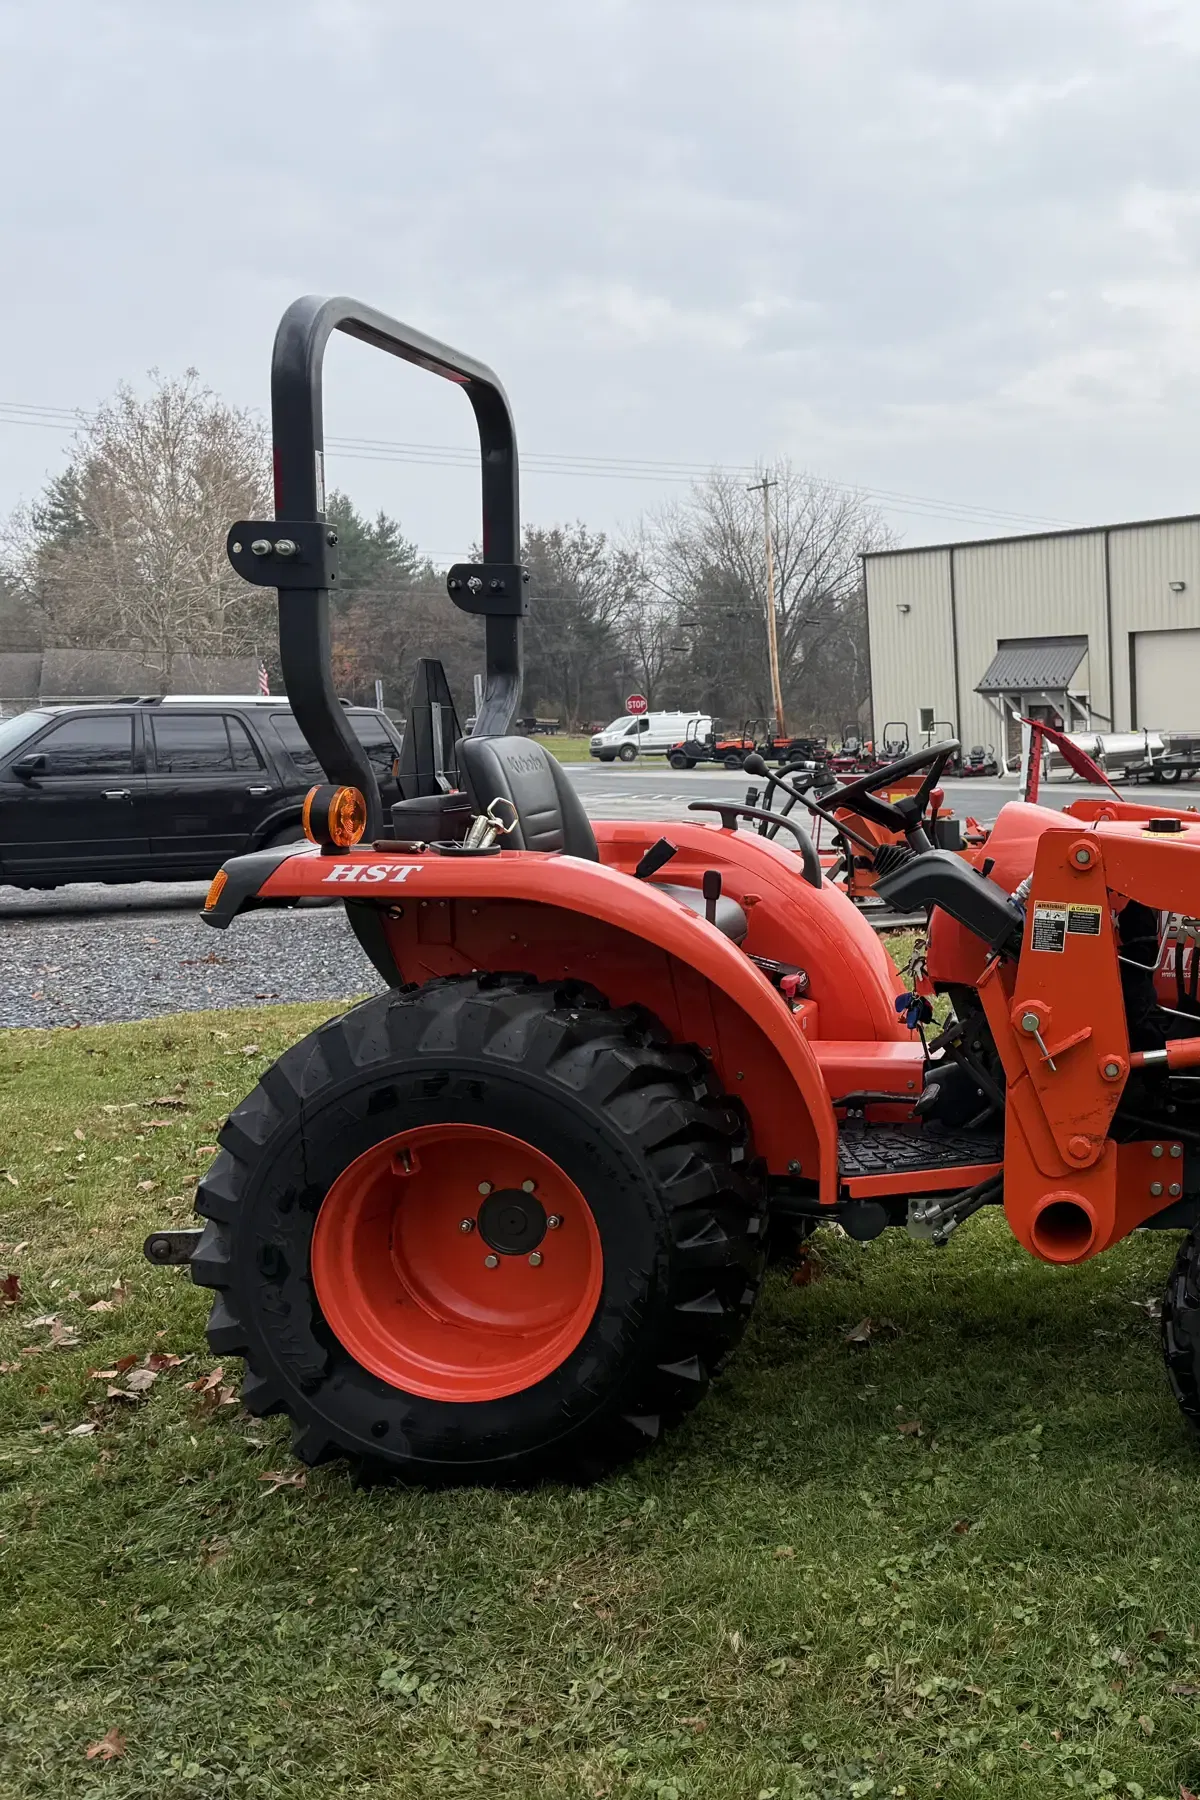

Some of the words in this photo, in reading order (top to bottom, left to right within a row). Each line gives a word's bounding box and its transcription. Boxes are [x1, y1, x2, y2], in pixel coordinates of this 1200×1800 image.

[627, 700, 646, 709] STOP
[506, 752, 545, 774] Kubota
[321, 864, 424, 883] HST
